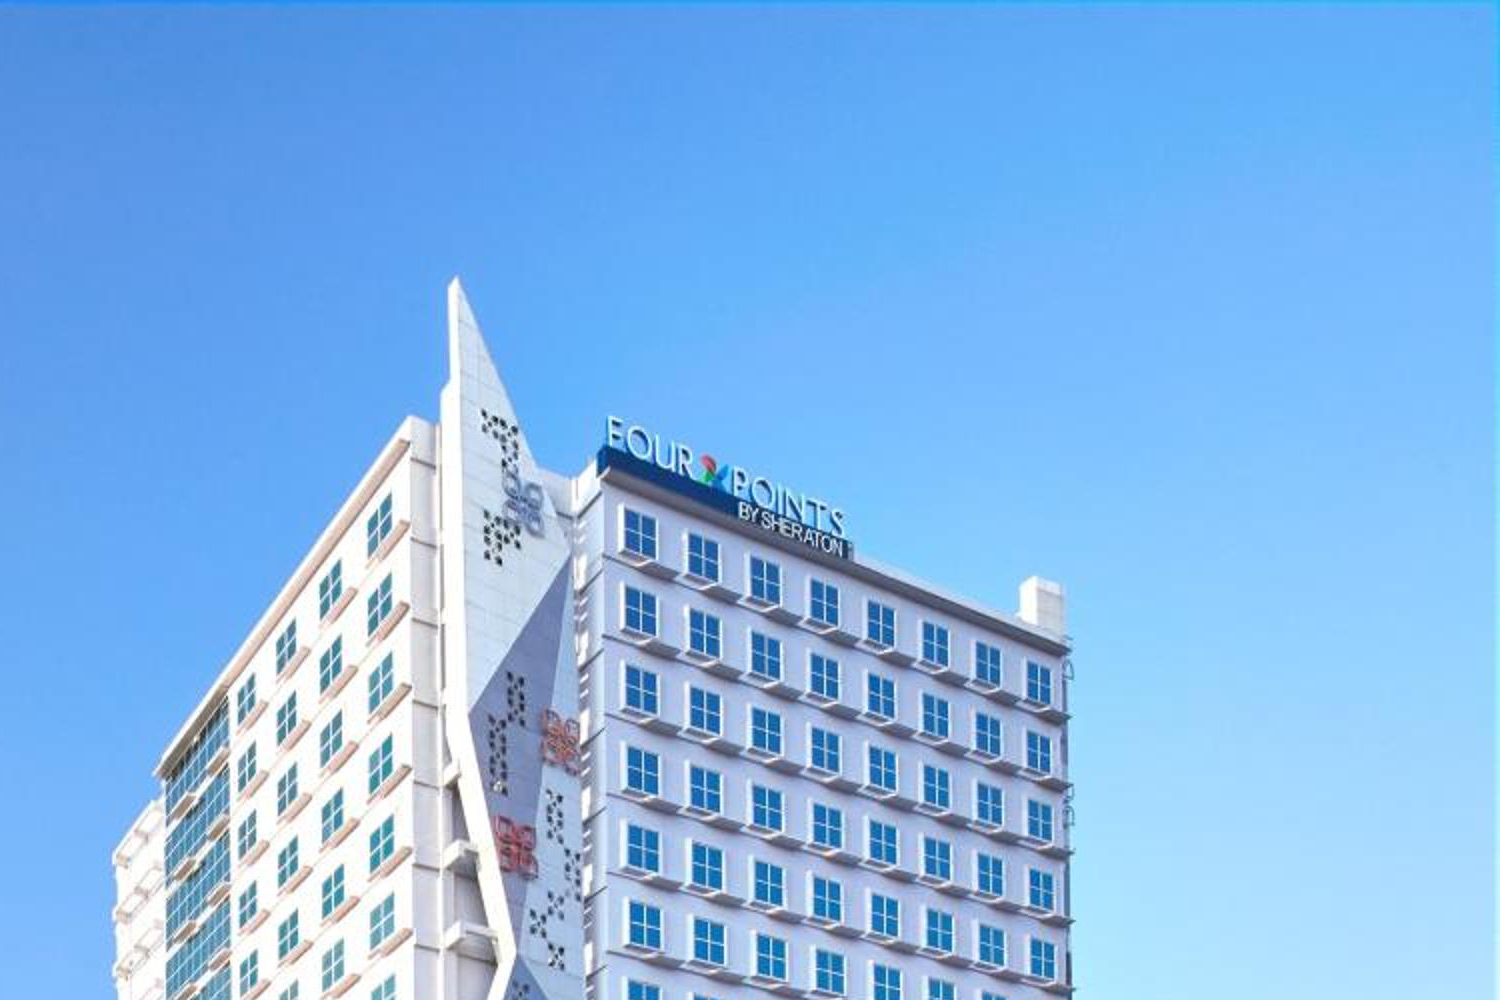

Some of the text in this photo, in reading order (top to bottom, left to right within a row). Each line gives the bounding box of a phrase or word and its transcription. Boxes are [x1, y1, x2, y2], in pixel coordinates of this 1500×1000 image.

[606, 415, 846, 539] FOUR POINTS
[738, 501, 843, 558] BY SHERATON
